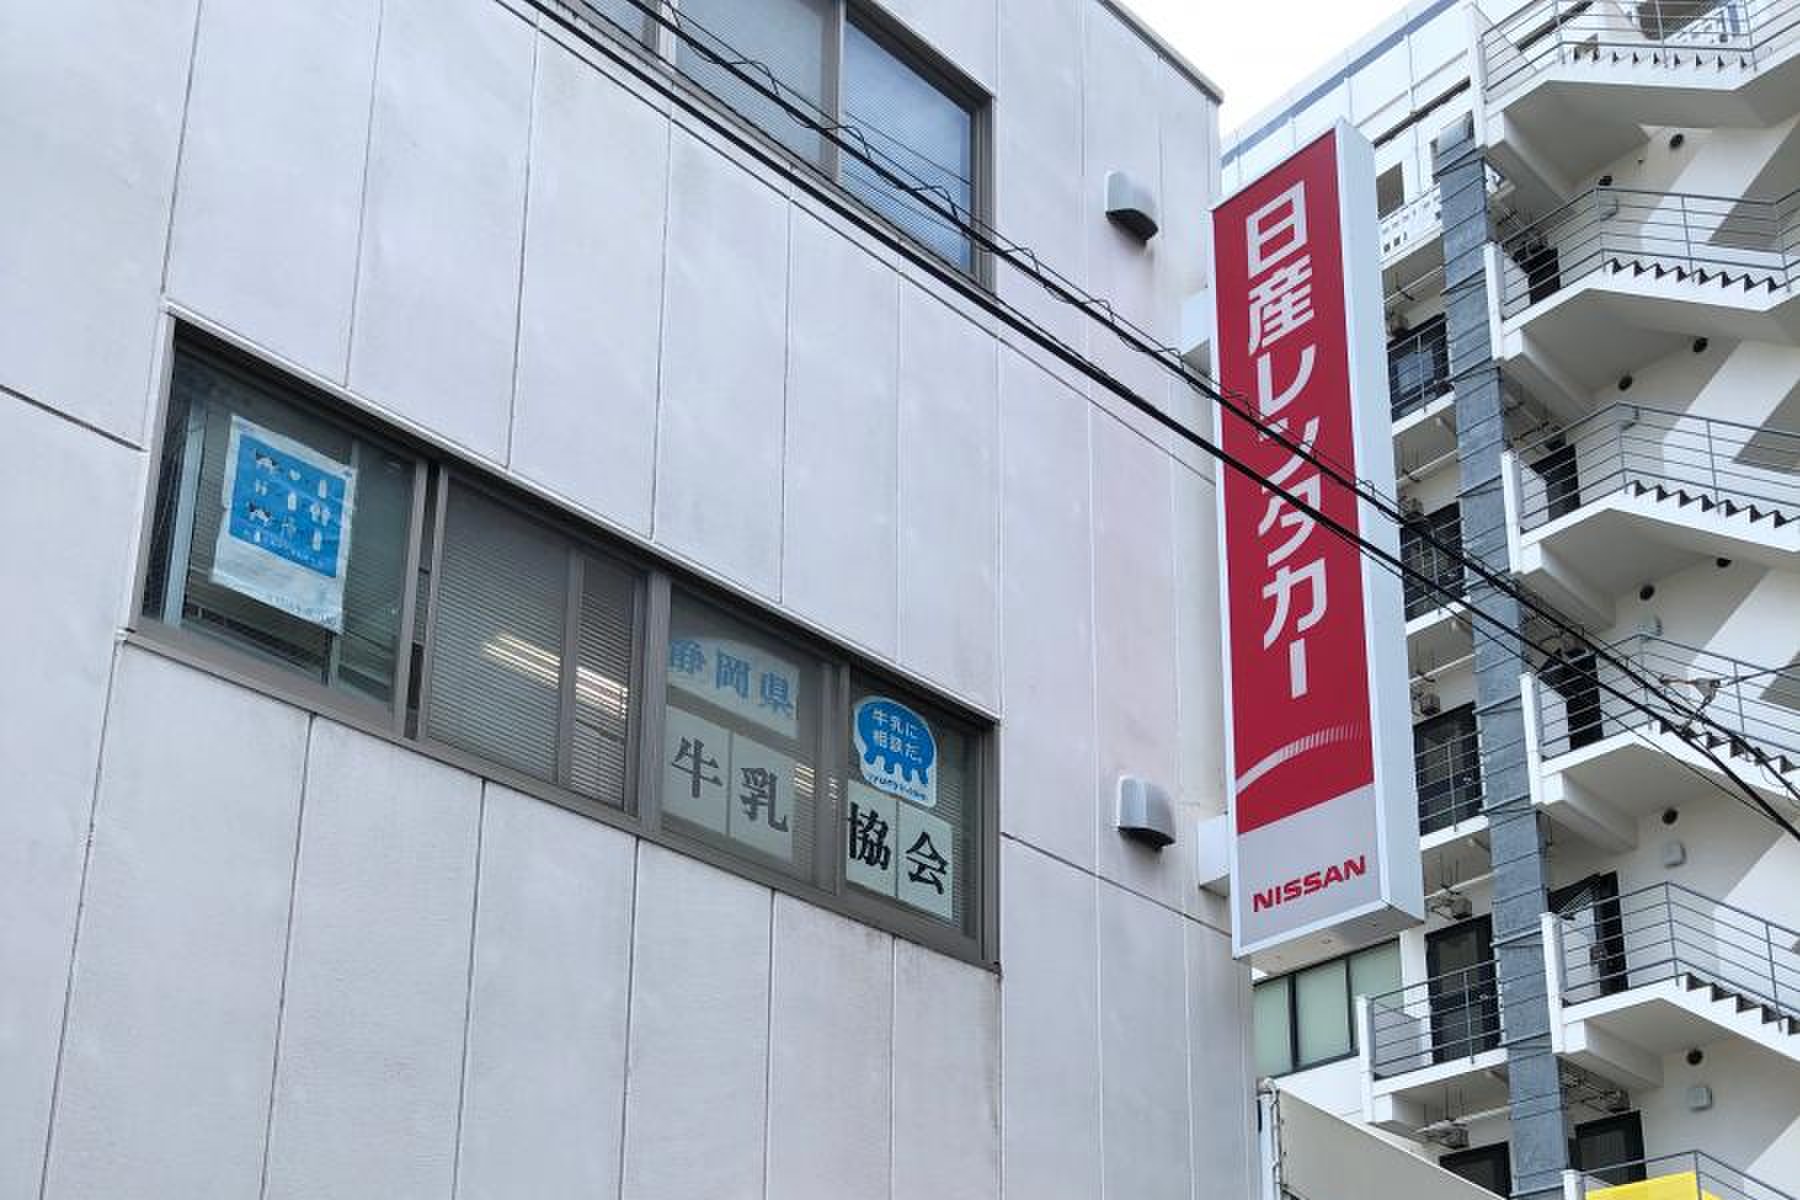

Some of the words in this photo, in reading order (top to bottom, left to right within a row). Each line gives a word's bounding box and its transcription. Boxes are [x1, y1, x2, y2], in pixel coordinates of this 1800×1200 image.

[1246, 180, 1328, 698] 日産レンタカー
[669, 639, 794, 713] 静岡県
[1253, 855, 1366, 912] NISSAN
